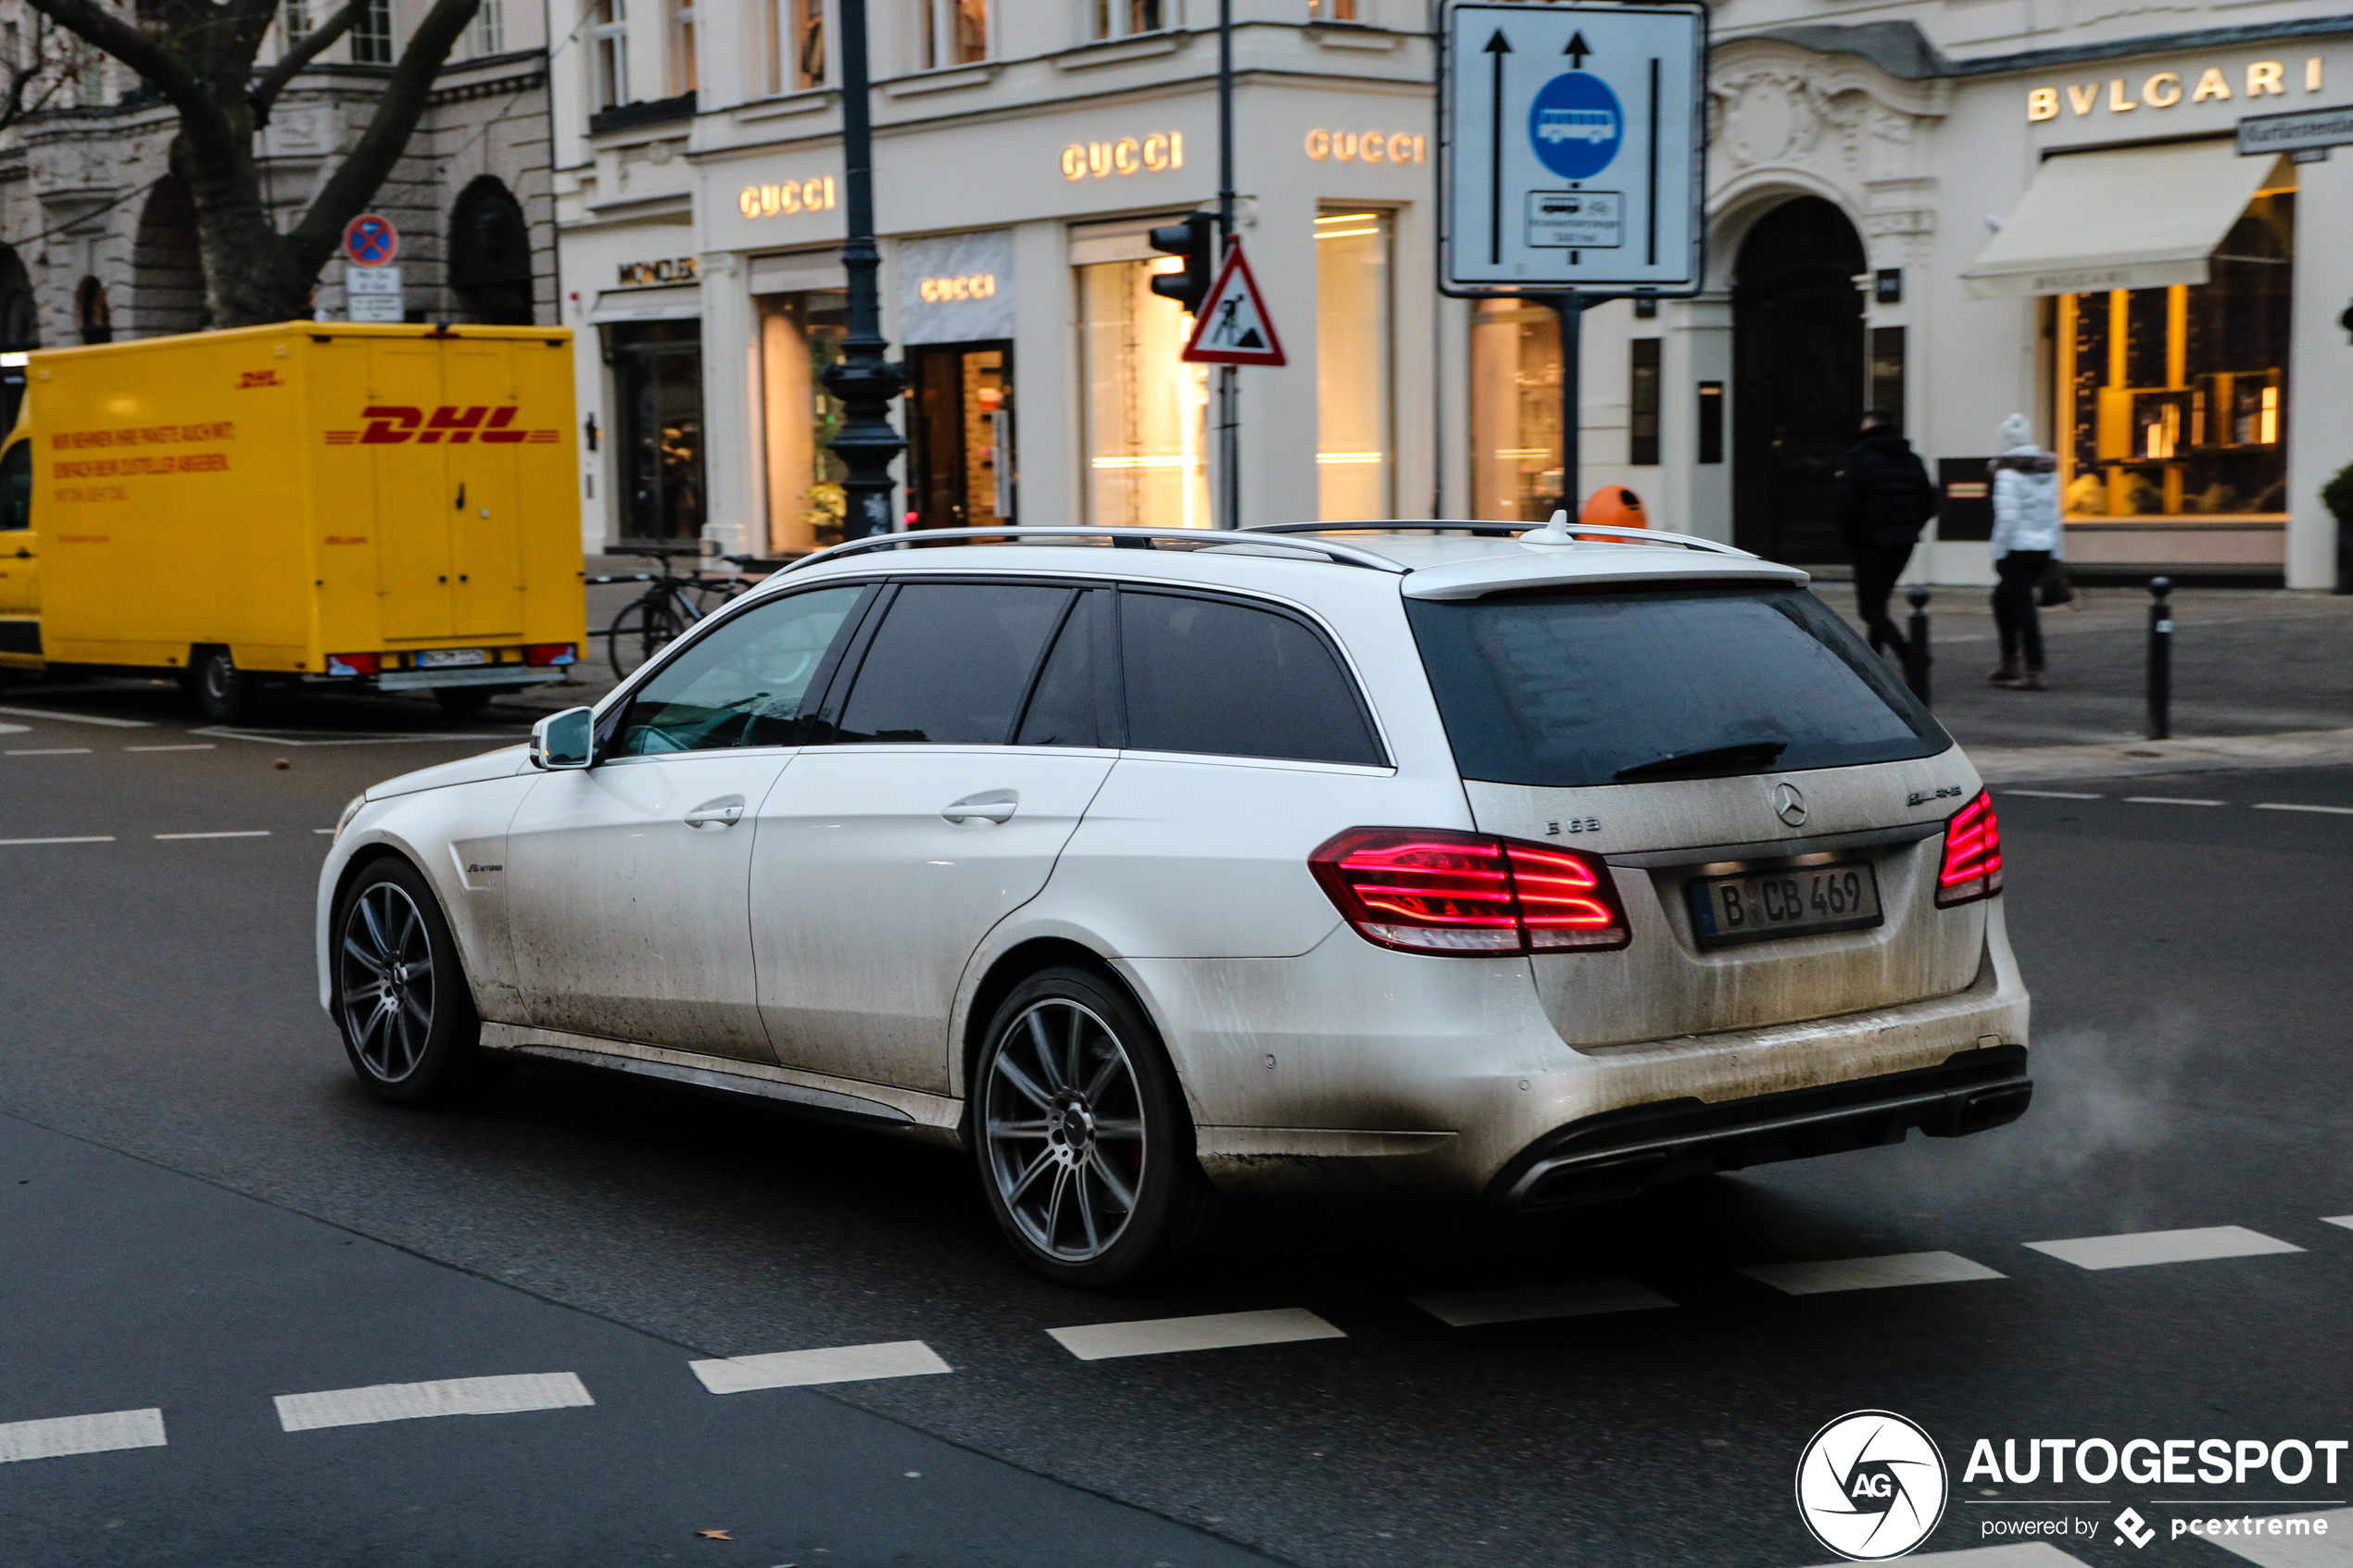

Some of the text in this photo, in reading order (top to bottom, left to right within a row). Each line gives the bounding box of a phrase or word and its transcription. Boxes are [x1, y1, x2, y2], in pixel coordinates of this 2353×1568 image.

[2027, 56, 2323, 122] BVLGARI
[1062, 132, 1183, 181] GUCCI
[1304, 128, 1426, 164] GUCCI
[739, 176, 836, 219] GUCCI
[920, 274, 996, 303] GUCCI
[359, 406, 529, 445] DHL
[1543, 817, 1601, 835] E 63
[1720, 872, 1860, 927] B CB 469
